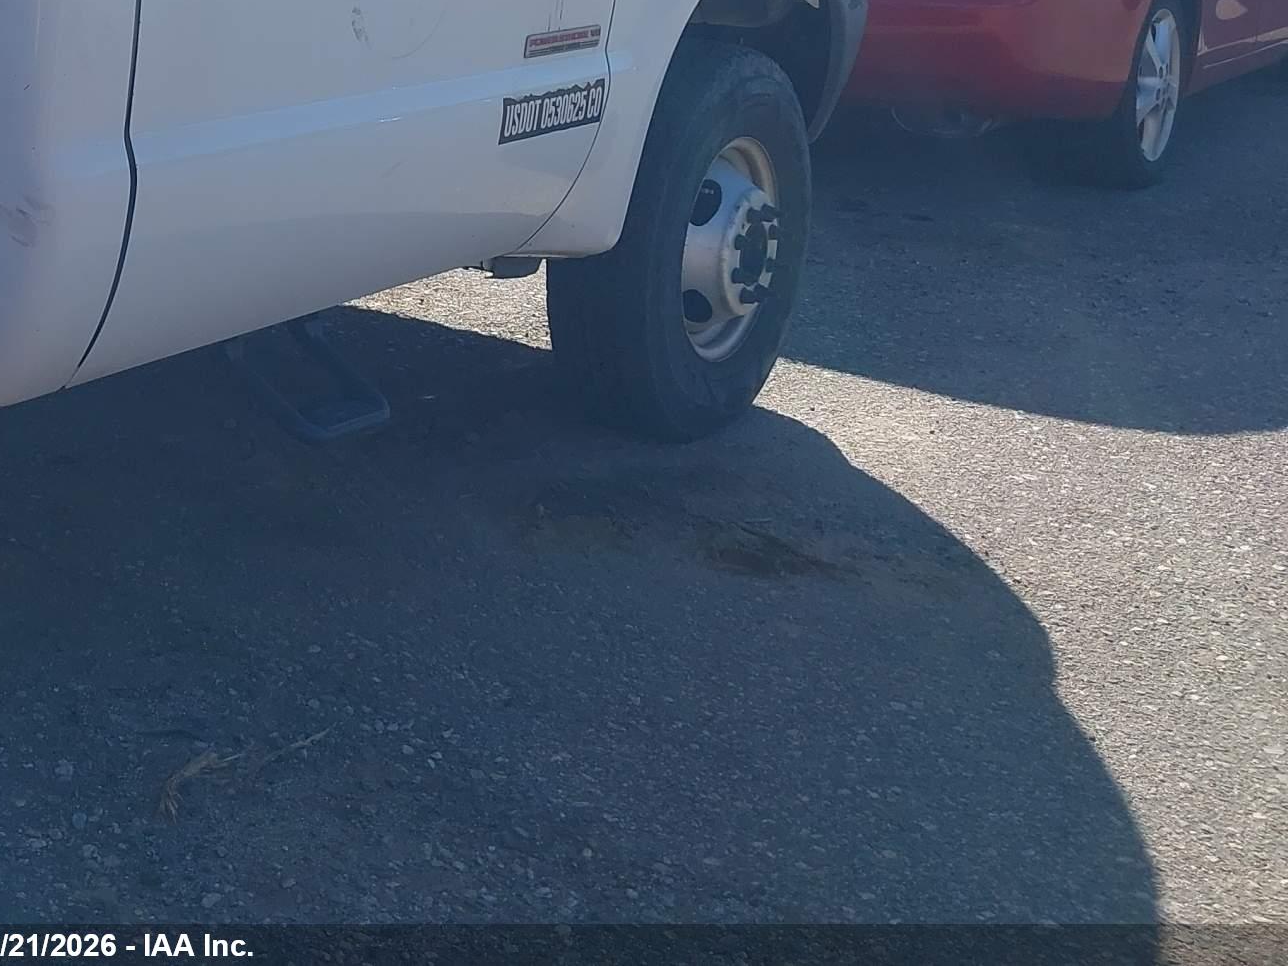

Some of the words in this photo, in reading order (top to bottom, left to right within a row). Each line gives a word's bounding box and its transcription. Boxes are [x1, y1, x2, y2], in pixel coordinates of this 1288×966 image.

[504, 99, 542, 137] USDOT
[540, 90, 589, 130] 0530625
[587, 86, 603, 119] CO
